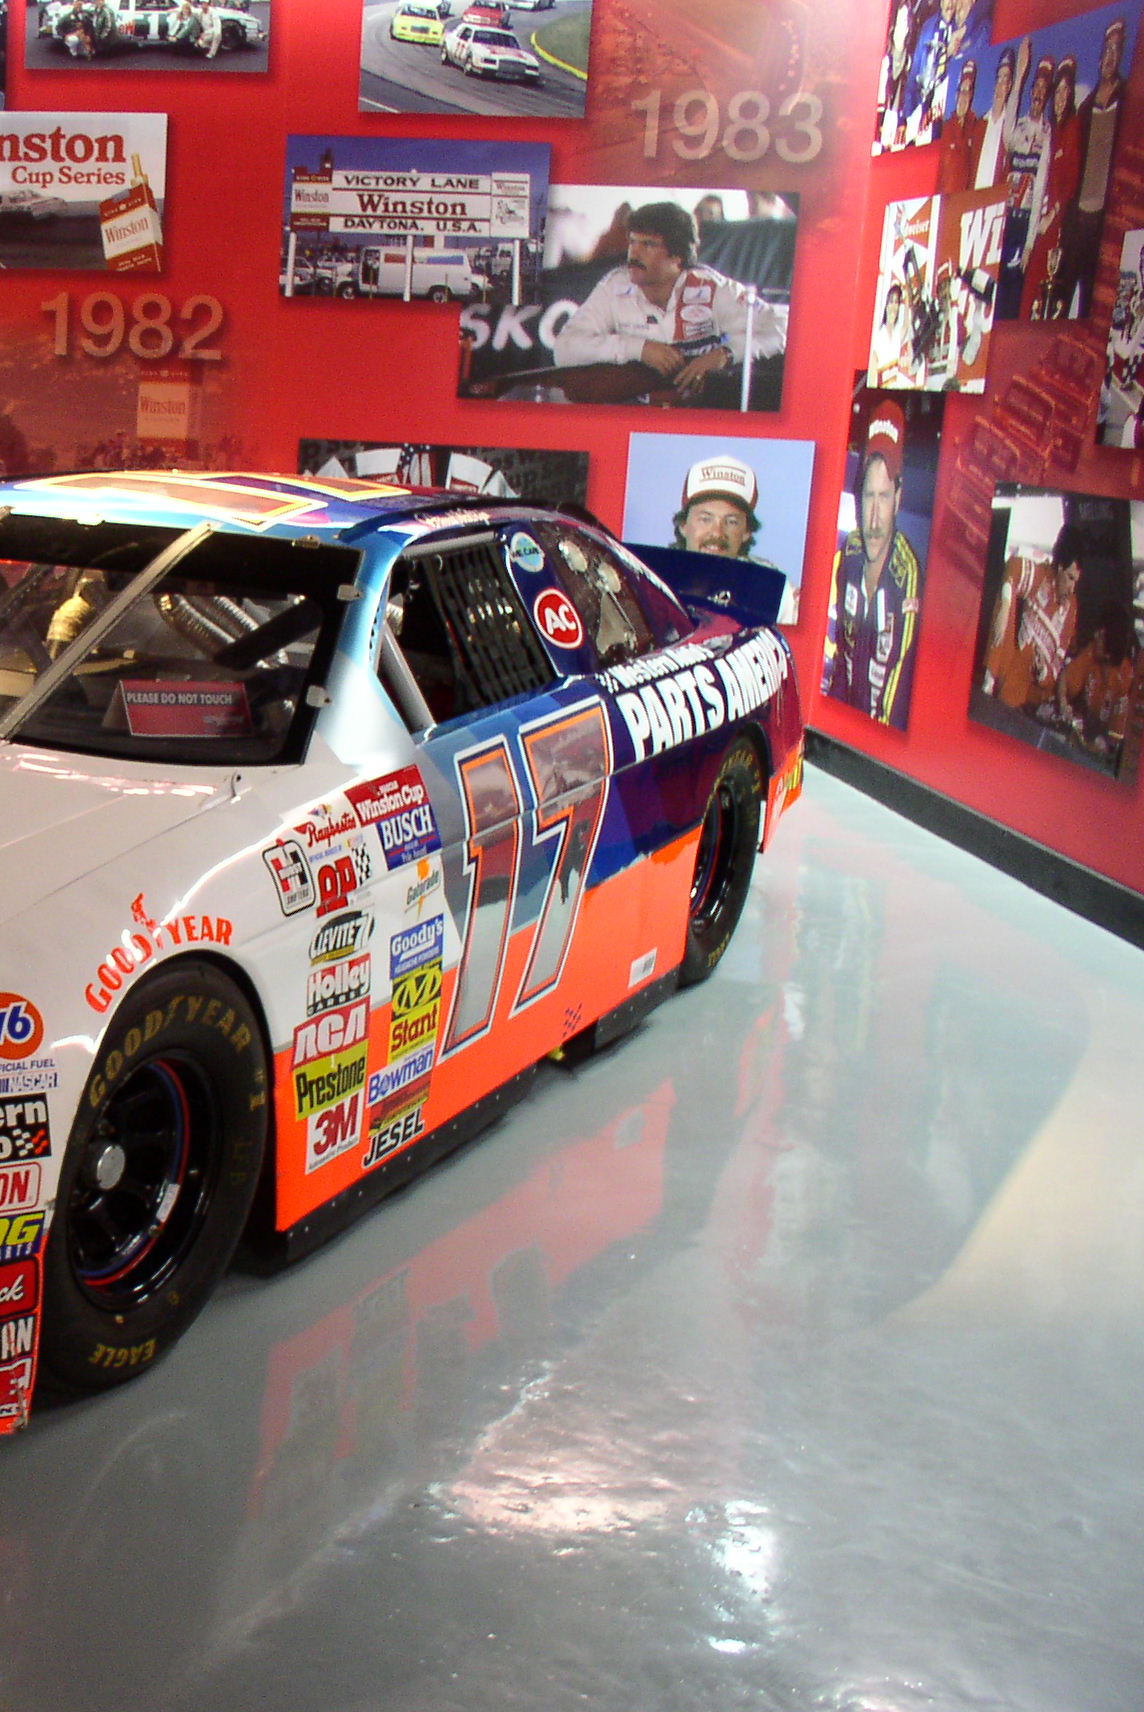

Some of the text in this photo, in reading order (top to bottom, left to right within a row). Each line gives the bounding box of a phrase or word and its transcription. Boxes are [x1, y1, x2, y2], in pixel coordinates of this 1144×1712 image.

[631, 90, 823, 163] 1983
[11, 166, 126, 189] Cup Series
[295, 188, 329, 203] Winston
[344, 174, 479, 190] VICTORY LANE
[356, 193, 468, 217] Winston
[104, 216, 150, 245] Winston
[436, 222, 482, 233] U.S.A.
[40, 291, 224, 361] 1982
[140, 396, 186, 415] Winston
[700, 466, 746, 484] Winston
[544, 604, 575, 635] AC
[127, 692, 232, 705] PLEASE DO NOT TOUCH
[616, 665, 724, 762] PARTS
[356, 791, 404, 822] Winston
[401, 784, 424, 804] Cup
[380, 804, 433, 850] BUSCH
[436, 695, 614, 1065] 17
[391, 918, 443, 956] Goody's
[308, 957, 369, 1005] Holley
[392, 1004, 437, 1053] Stant
[30, 1058, 56, 1070] FUEL
[368, 1049, 433, 1104] Bowman
[296, 1056, 366, 1114] Prestone
[313, 1092, 359, 1155] 3M
[363, 1108, 424, 1167] JESEL
[89, 1338, 156, 1368] EAGLE
